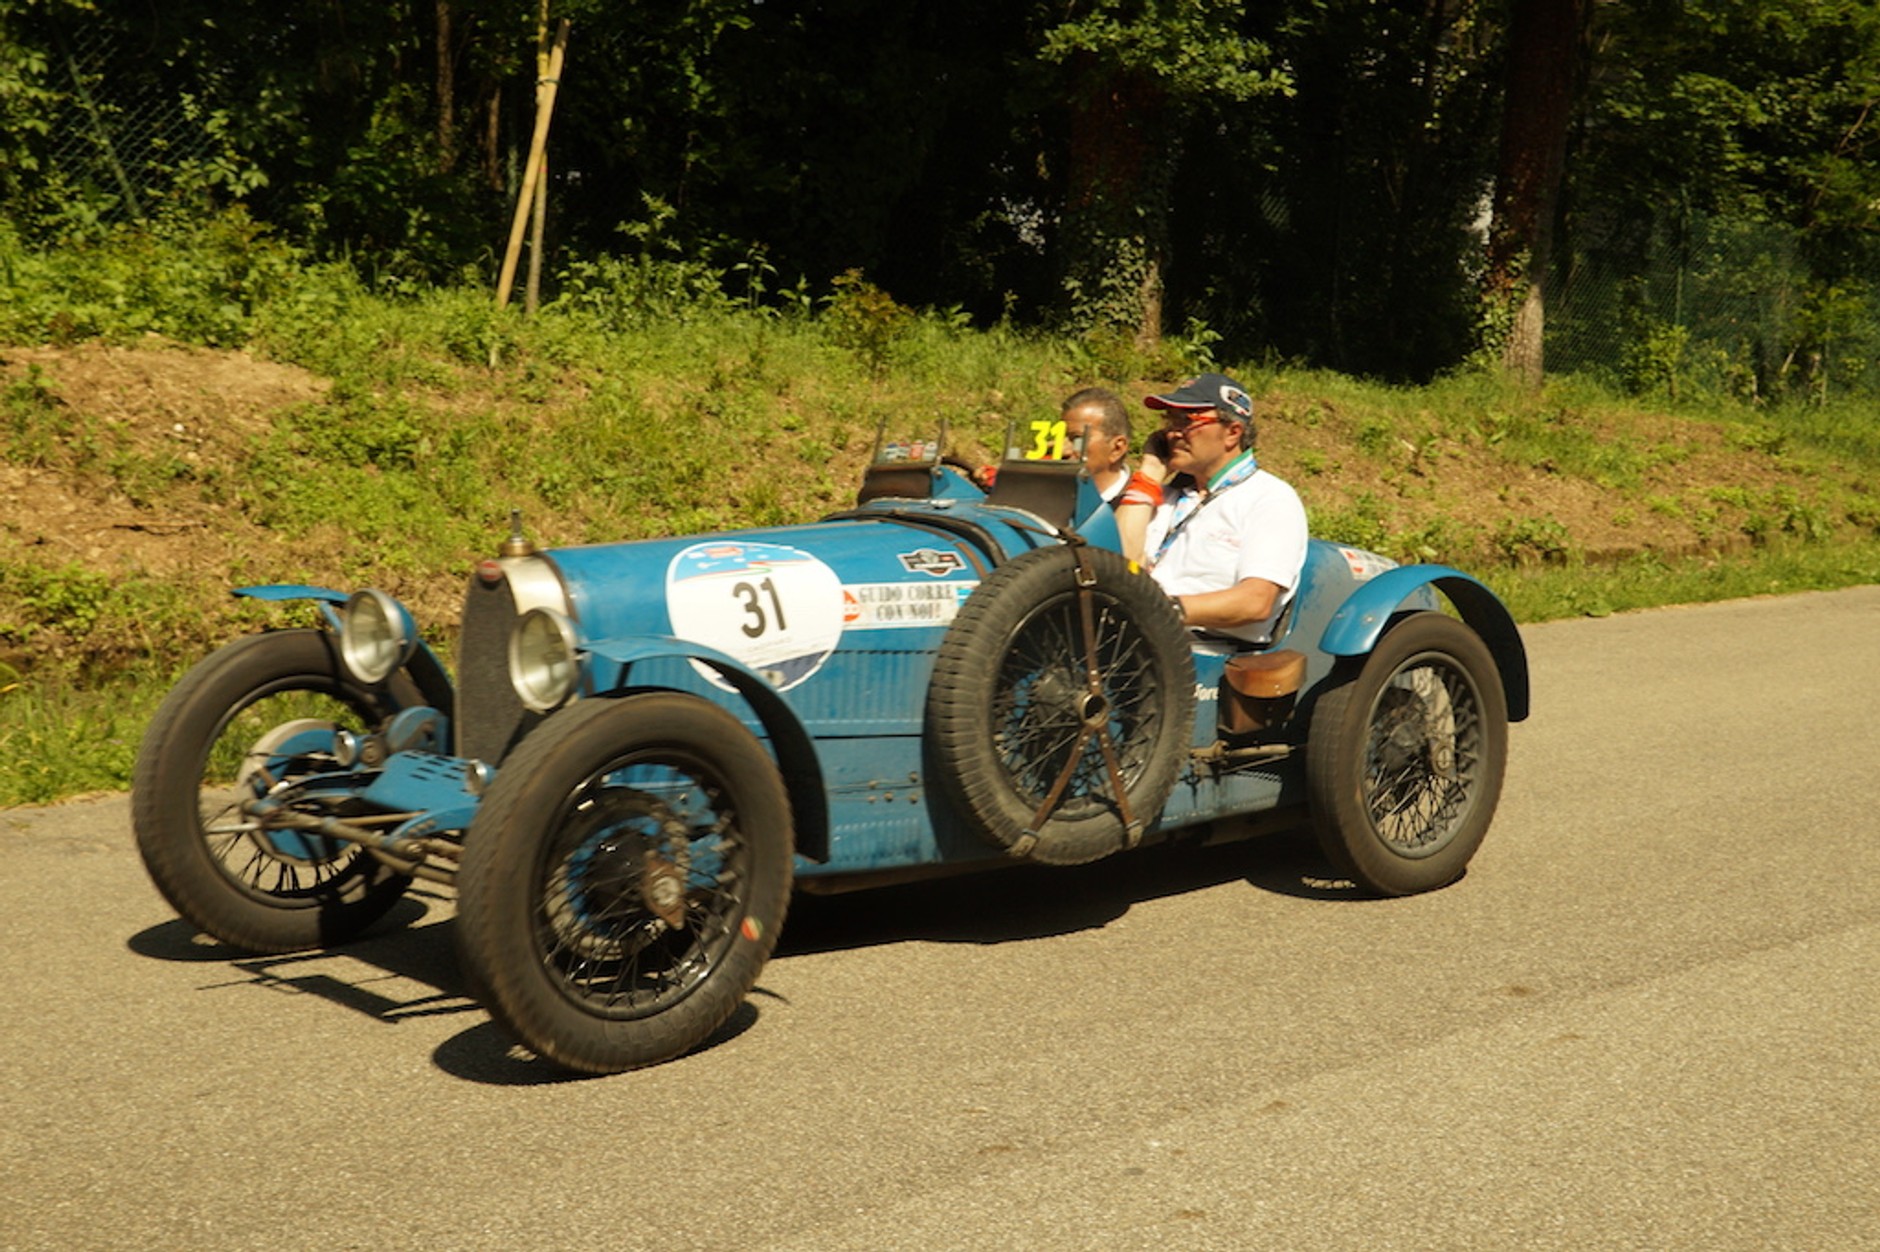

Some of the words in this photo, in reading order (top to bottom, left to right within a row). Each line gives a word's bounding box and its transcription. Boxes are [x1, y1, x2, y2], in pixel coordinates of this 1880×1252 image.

[1025, 421, 1066, 460] 31
[732, 577, 785, 638] 31
[859, 585, 902, 603] GUIDO
[907, 584, 953, 600] CORRE
[876, 603, 904, 620] CON
